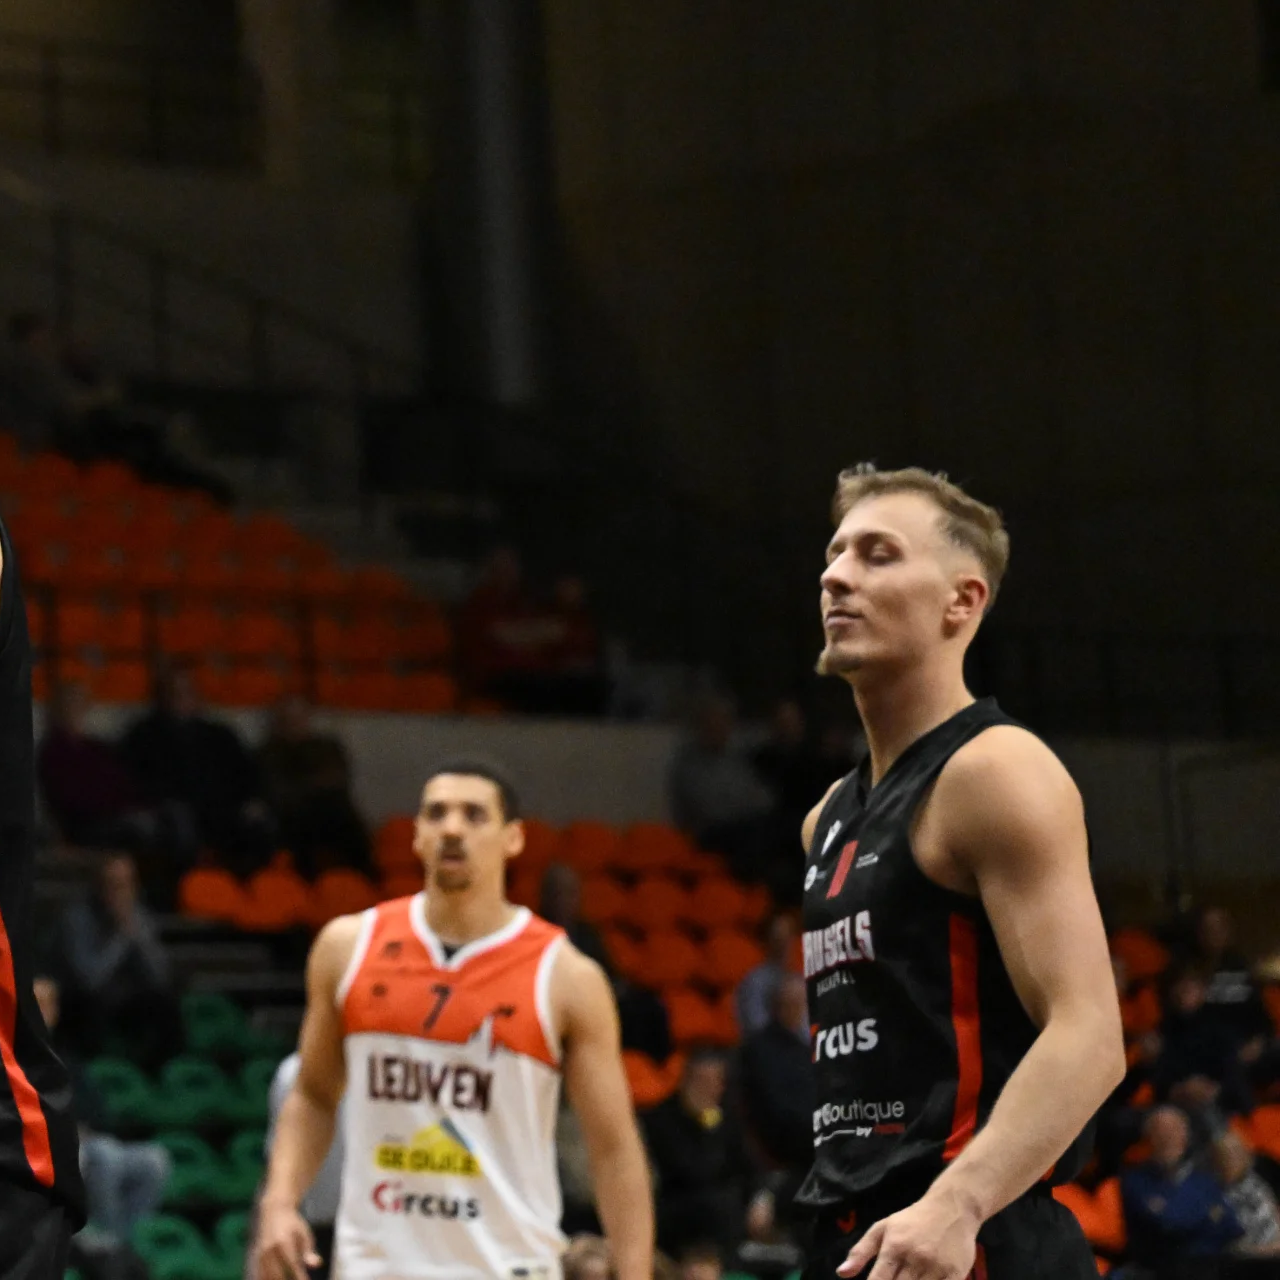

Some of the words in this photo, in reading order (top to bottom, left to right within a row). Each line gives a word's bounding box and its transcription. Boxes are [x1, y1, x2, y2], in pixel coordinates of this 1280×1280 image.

[423, 985, 450, 1031] 7
[369, 1054, 493, 1111] LEUVEN
[371, 1181, 480, 1219] Circus
